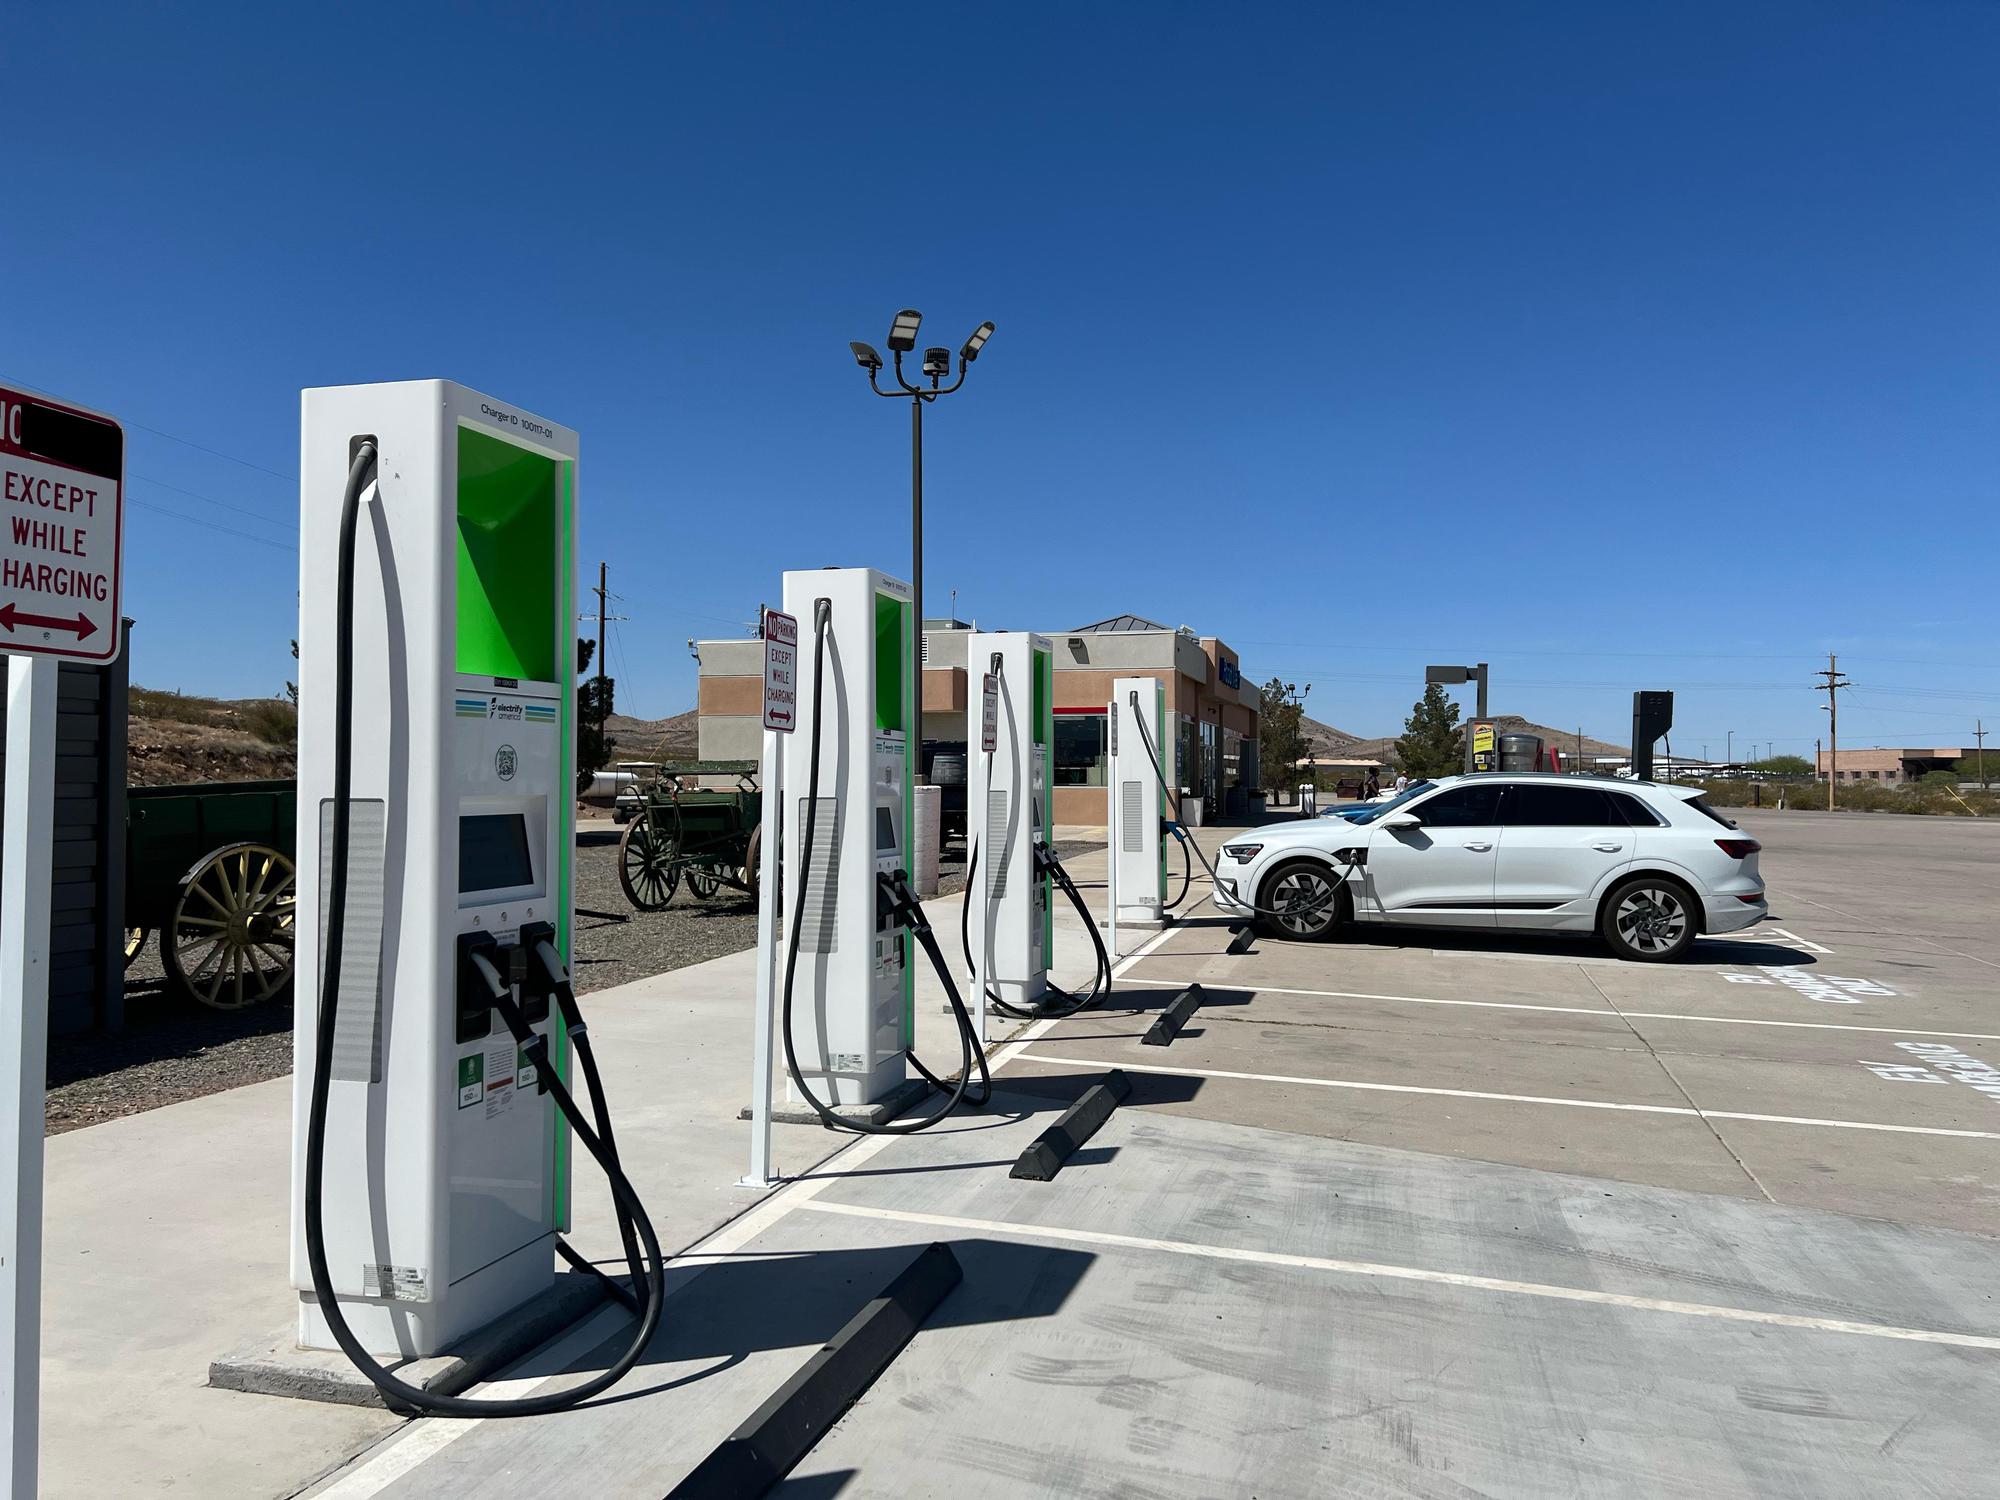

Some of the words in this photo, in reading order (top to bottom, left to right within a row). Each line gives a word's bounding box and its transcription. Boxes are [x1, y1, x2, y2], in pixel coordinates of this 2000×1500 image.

[481, 403, 509, 422] Charger
[510, 415, 518, 425] ID
[5, 470, 98, 518] EXCEPT
[11, 516, 87, 557] WHILE
[0, 558, 107, 602] HARGING
[768, 616, 777, 636] NO
[777, 620, 796, 640] PARKING
[771, 648, 792, 666] EXCEPT
[772, 668, 790, 685] WHILE
[767, 687, 794, 705] CHARGING
[497, 703, 522, 714] electrify
[1717, 971, 1777, 985] EV
[1817, 974, 1897, 996] ONLY
[1856, 1060, 1950, 1085] EV
[1894, 1041, 2000, 1104] ARGING
